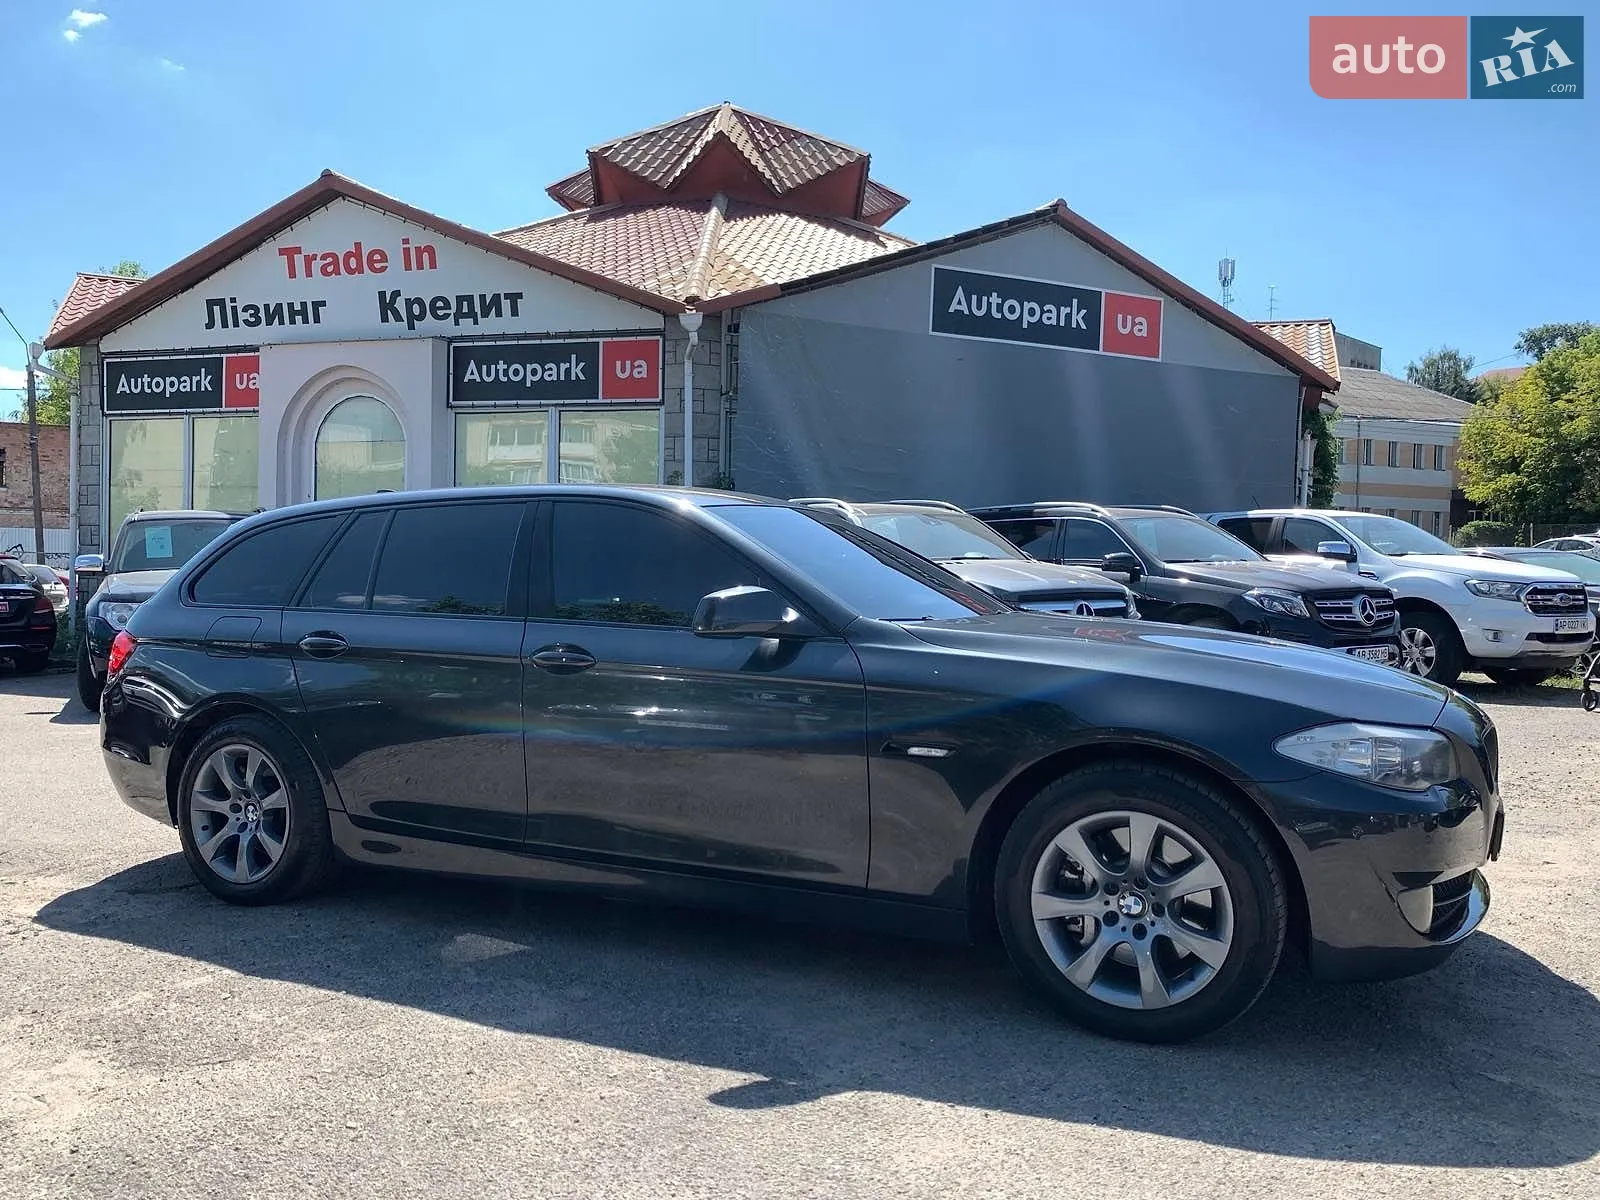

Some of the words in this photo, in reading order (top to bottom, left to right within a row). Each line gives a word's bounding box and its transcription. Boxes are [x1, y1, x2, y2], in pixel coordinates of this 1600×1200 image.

[278, 241, 388, 280] Trade
[402, 238, 438, 272] in
[204, 297, 327, 330] Лізинг
[377, 288, 523, 331] Кредит
[948, 285, 1088, 330] Autopark
[1117, 313, 1148, 337] ua
[116, 367, 213, 398] Autopark
[235, 372, 259, 390] ua
[463, 354, 586, 387] Autopark
[615, 359, 648, 379] ua
